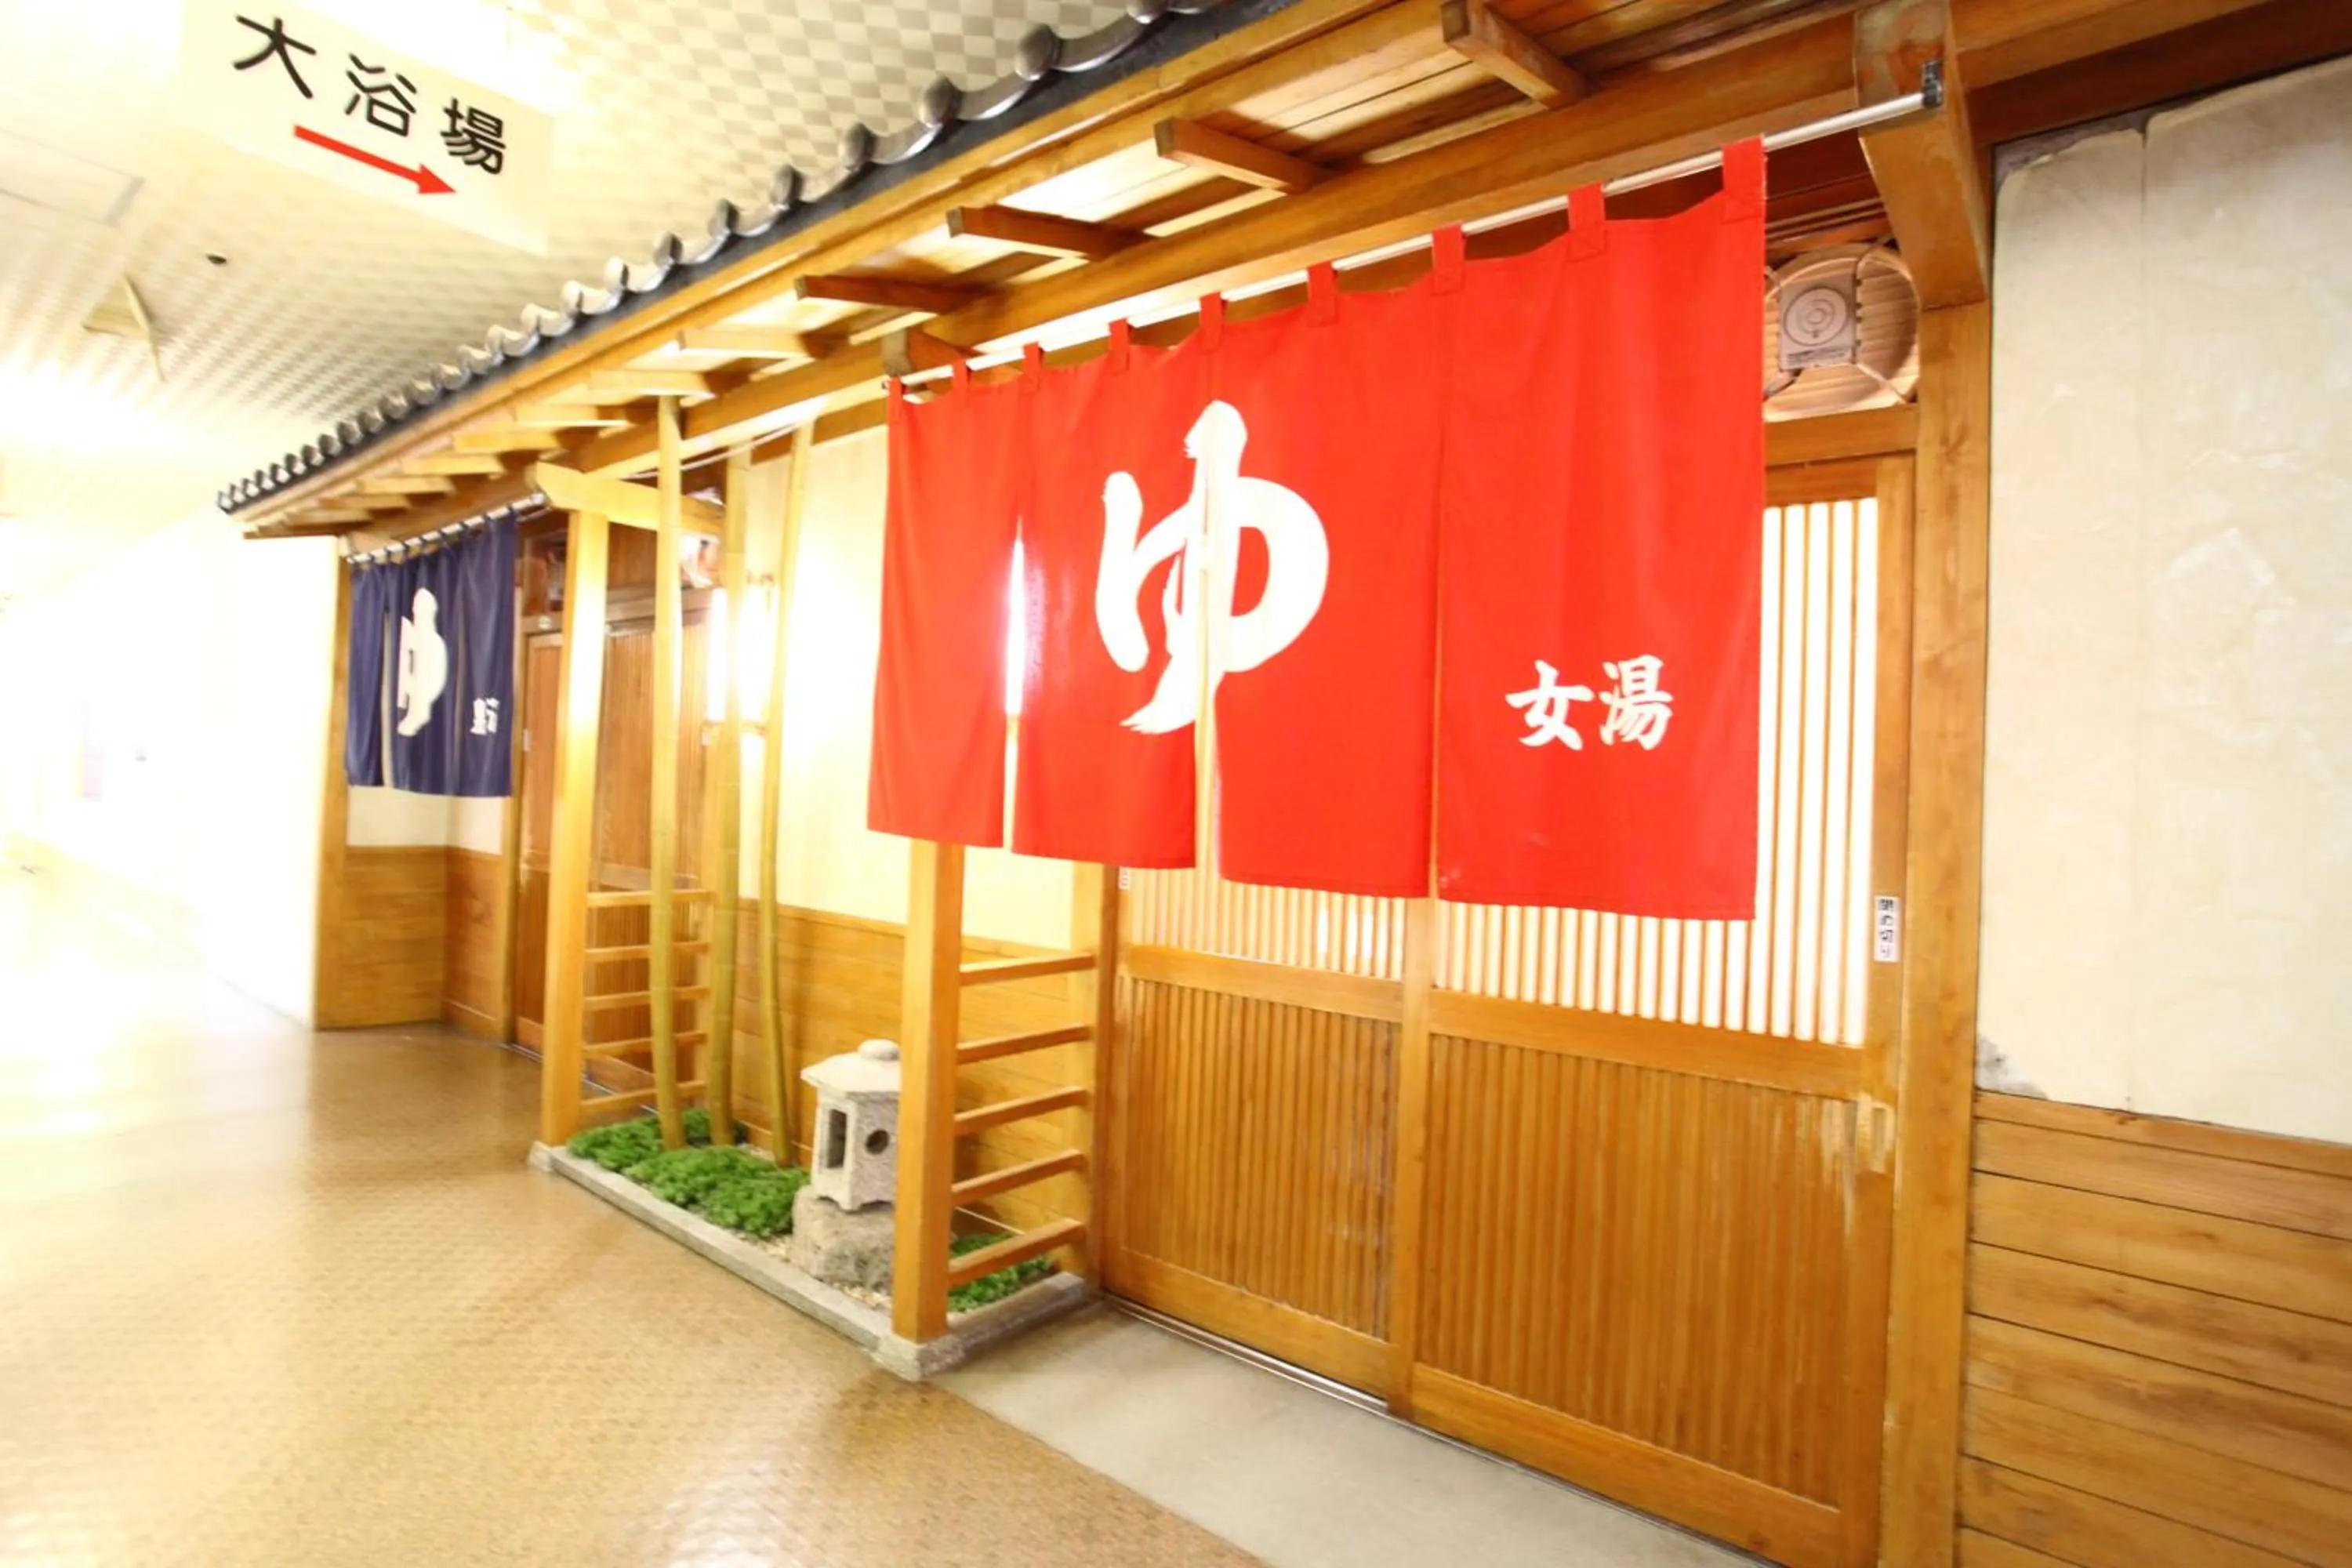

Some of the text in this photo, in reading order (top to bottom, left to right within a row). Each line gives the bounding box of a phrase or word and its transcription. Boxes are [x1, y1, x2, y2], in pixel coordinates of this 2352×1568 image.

[234, 15, 506, 175] 大浴場
[1094, 399, 1330, 735] ゆ
[1504, 654, 1674, 751] 女湯
